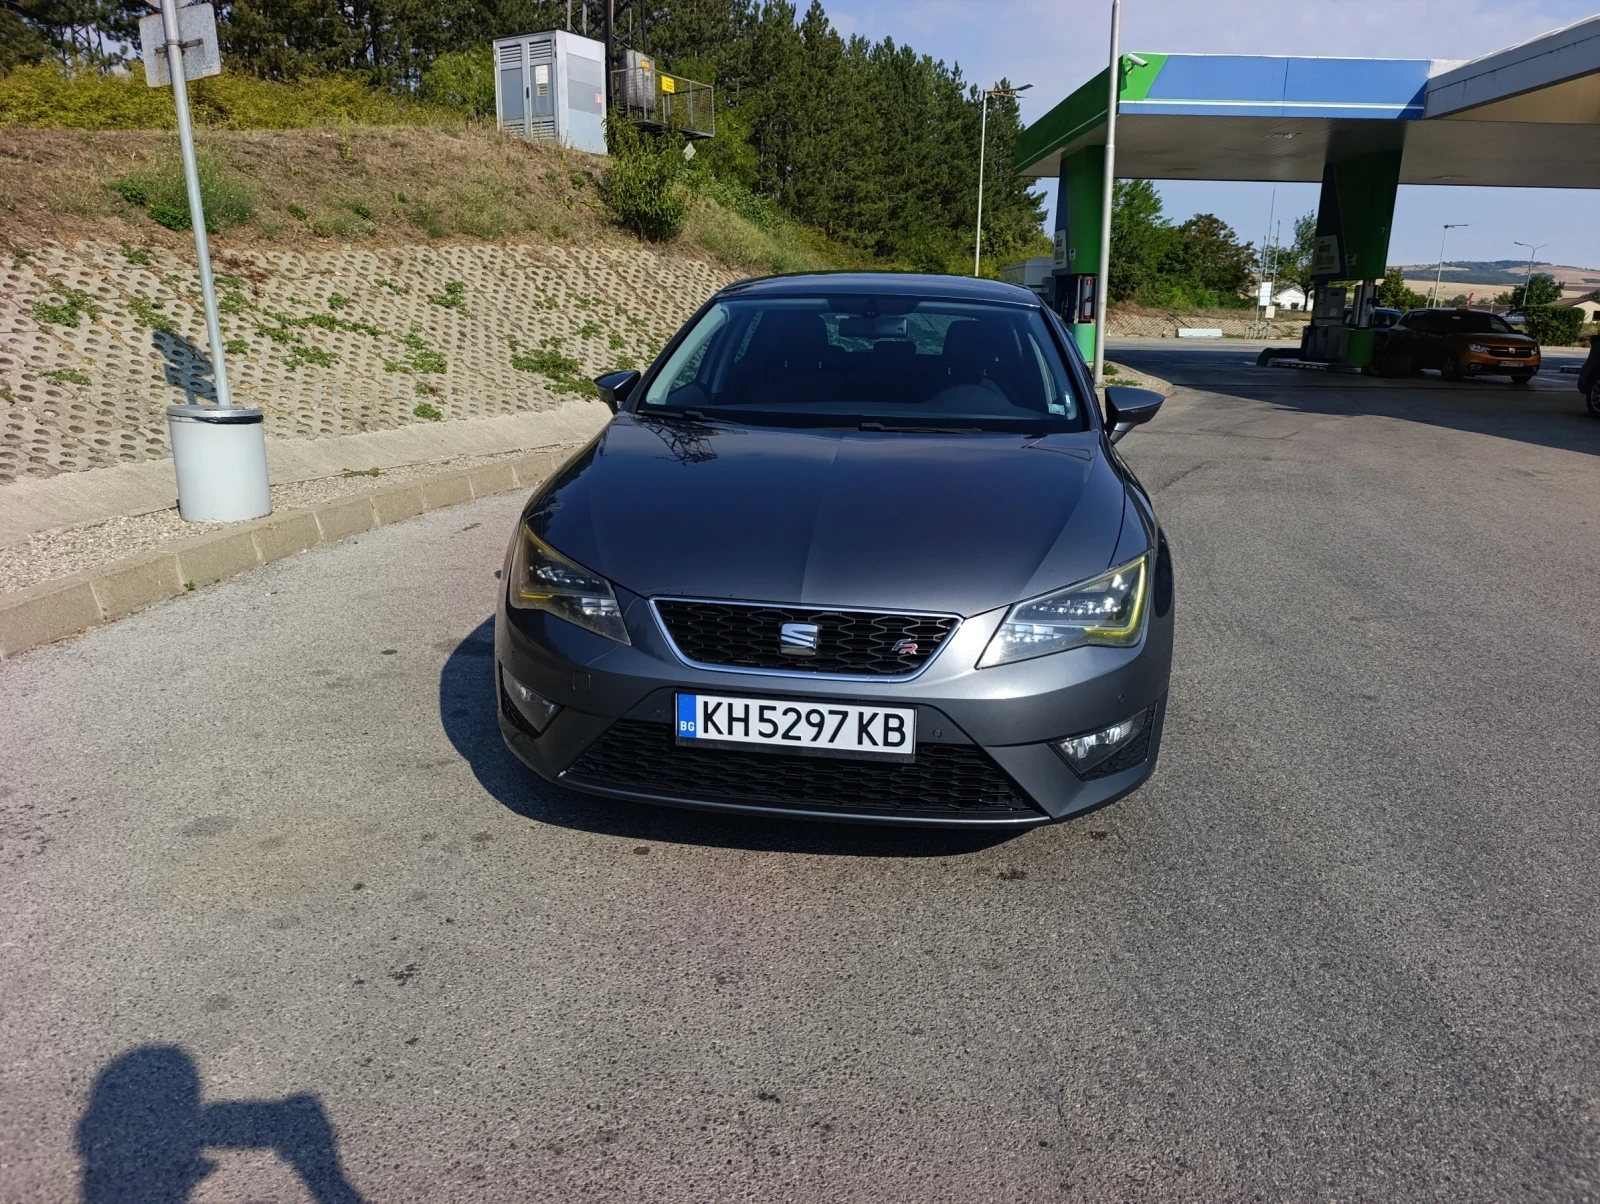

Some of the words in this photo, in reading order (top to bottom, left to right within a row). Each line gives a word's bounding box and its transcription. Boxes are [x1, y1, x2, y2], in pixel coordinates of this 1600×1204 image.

[891, 638, 918, 655] FR
[680, 721, 695, 732] BG
[703, 700, 750, 737] KH
[758, 704, 849, 744] 5297
[857, 711, 907, 748] KB
